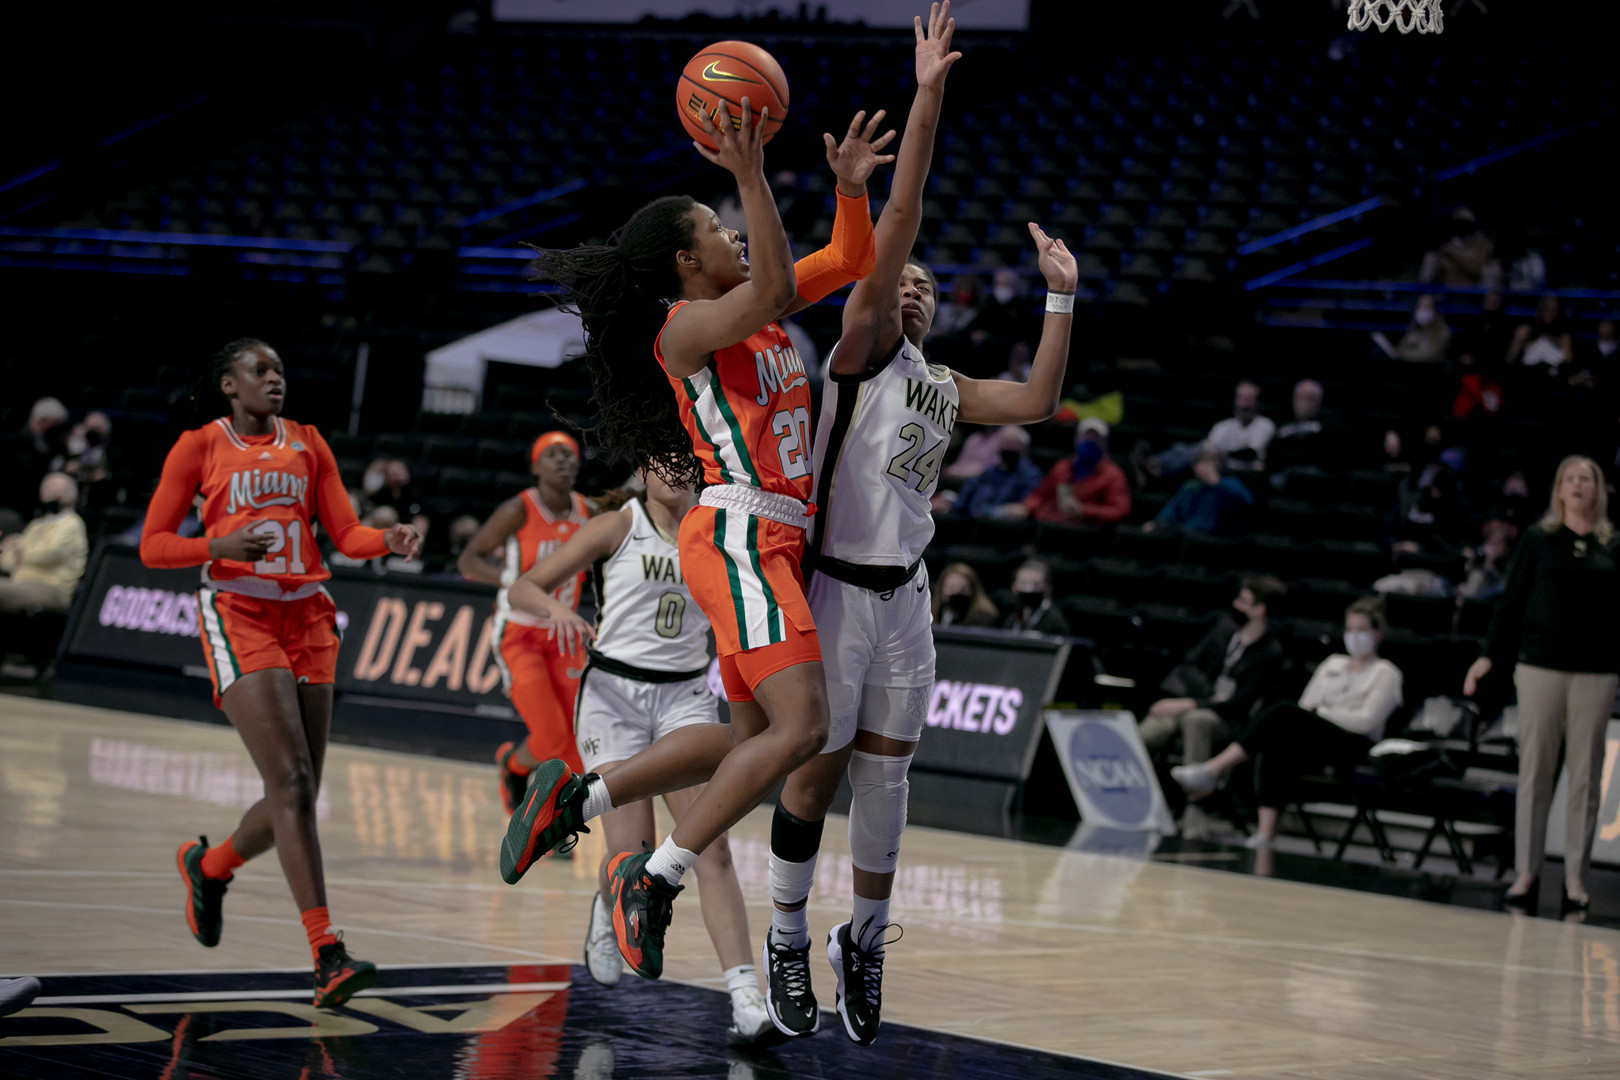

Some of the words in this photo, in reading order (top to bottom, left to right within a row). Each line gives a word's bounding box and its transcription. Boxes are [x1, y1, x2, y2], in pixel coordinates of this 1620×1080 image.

[771, 406, 813, 480] 20
[887, 422, 944, 493] 24
[226, 468, 308, 514] Miami
[253, 519, 306, 574] 21
[641, 554, 685, 584] WA
[655, 591, 686, 639] 0
[926, 679, 1023, 735] CKETS
